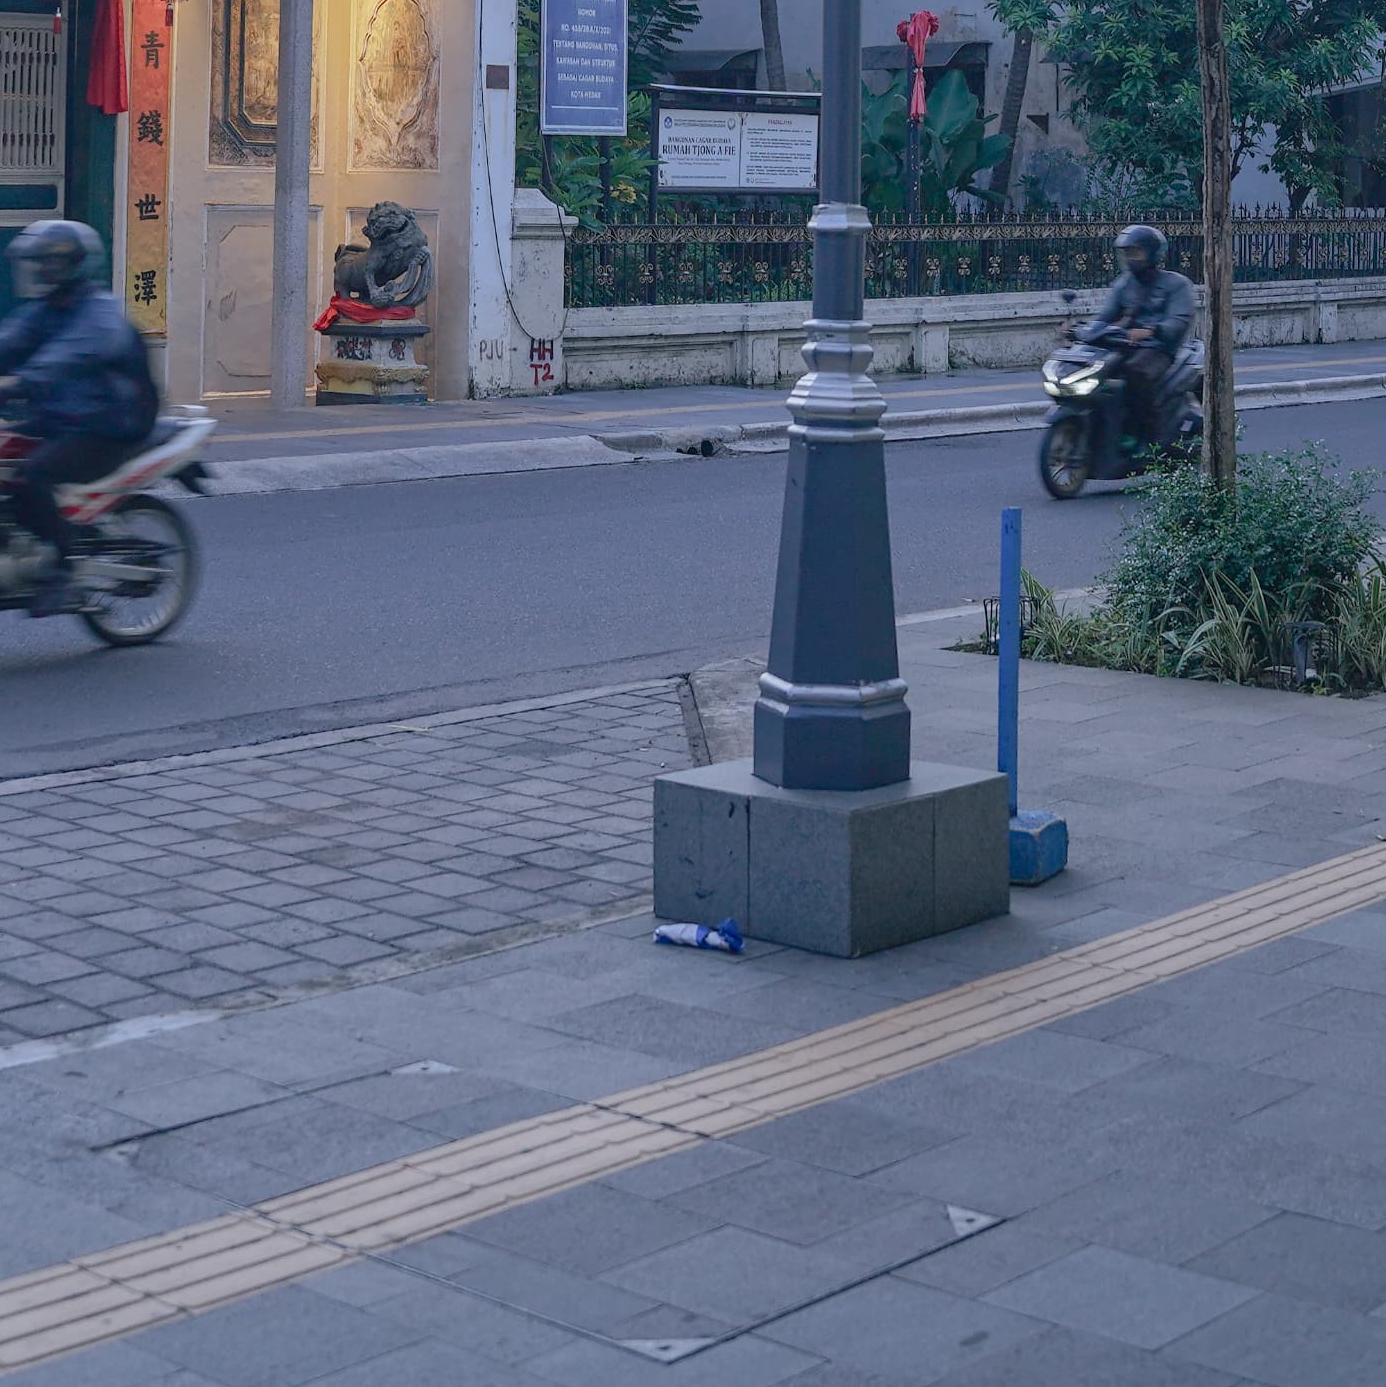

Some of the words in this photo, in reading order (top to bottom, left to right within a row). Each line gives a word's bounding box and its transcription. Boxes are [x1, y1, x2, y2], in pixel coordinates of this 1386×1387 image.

[662, 144, 690, 155] RUMAH
[691, 145, 716, 157] TJONG
[717, 145, 724, 156] A
[724, 145, 736, 156] FIE
[529, 362, 555, 387] T2
